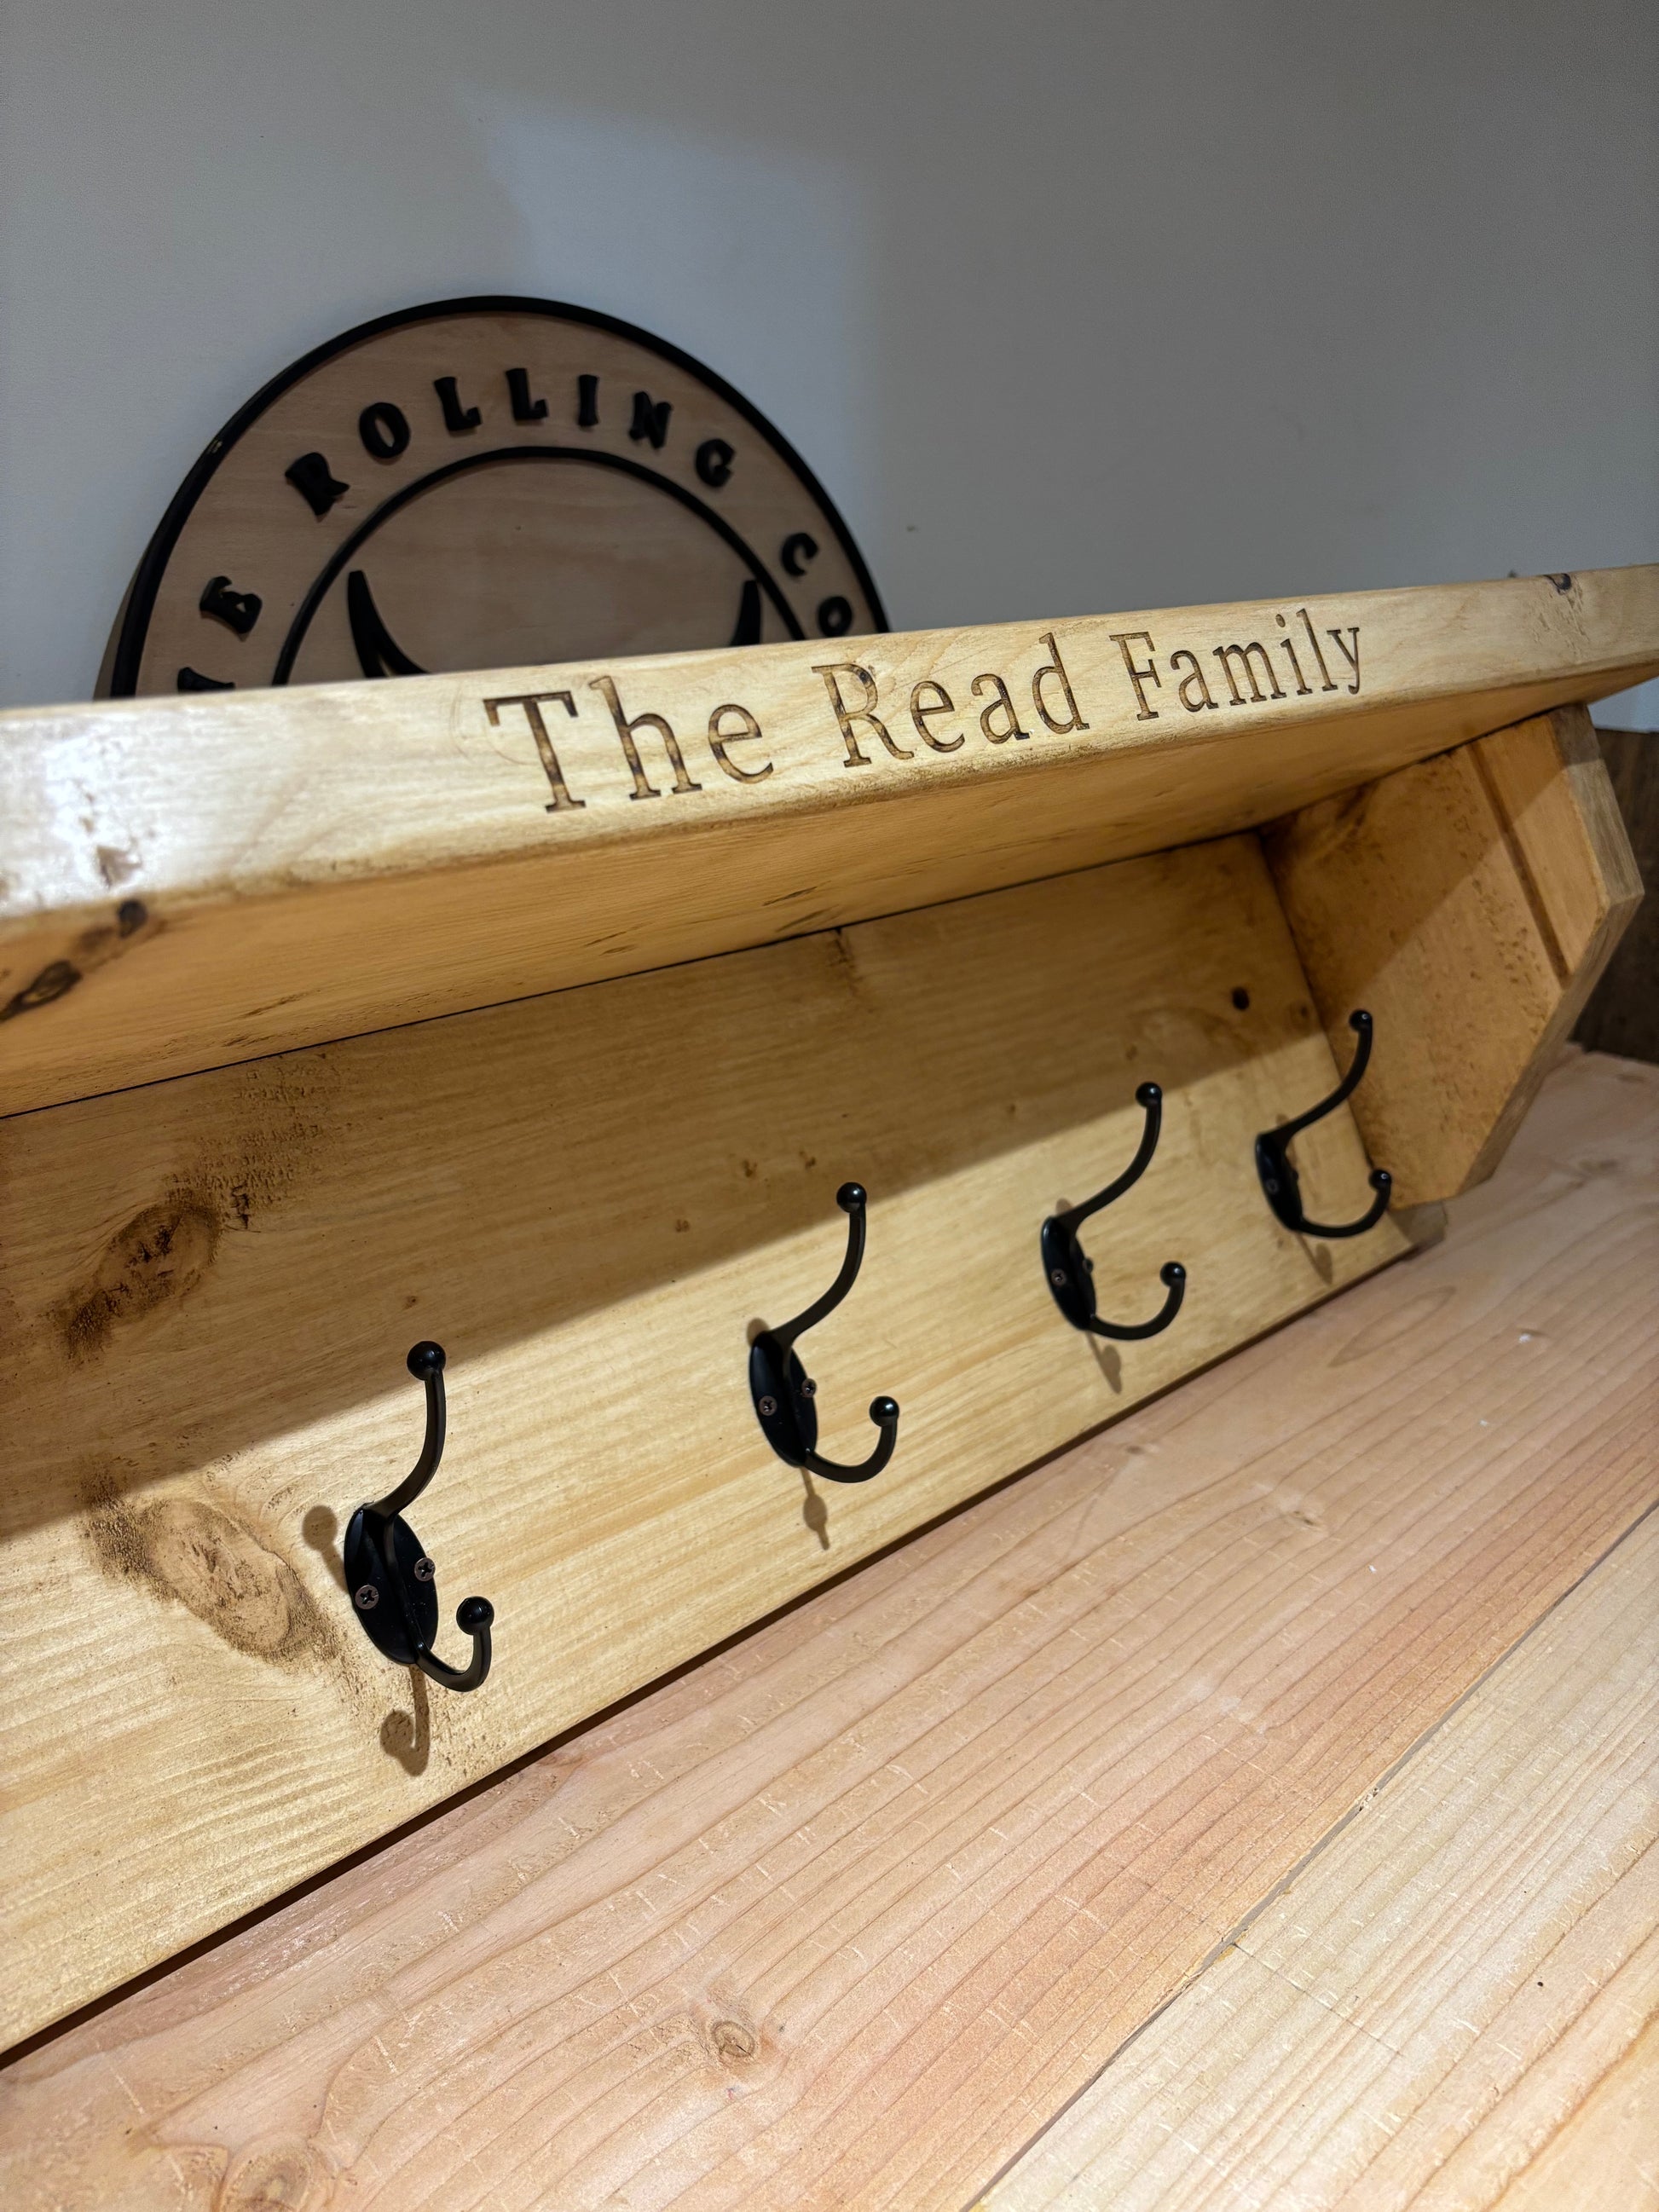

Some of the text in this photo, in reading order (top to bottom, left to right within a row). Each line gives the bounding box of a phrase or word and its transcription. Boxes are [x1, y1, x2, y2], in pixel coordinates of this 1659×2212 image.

[285, 367, 736, 517] ROLLING
[483, 608, 1362, 812] The Read Family
